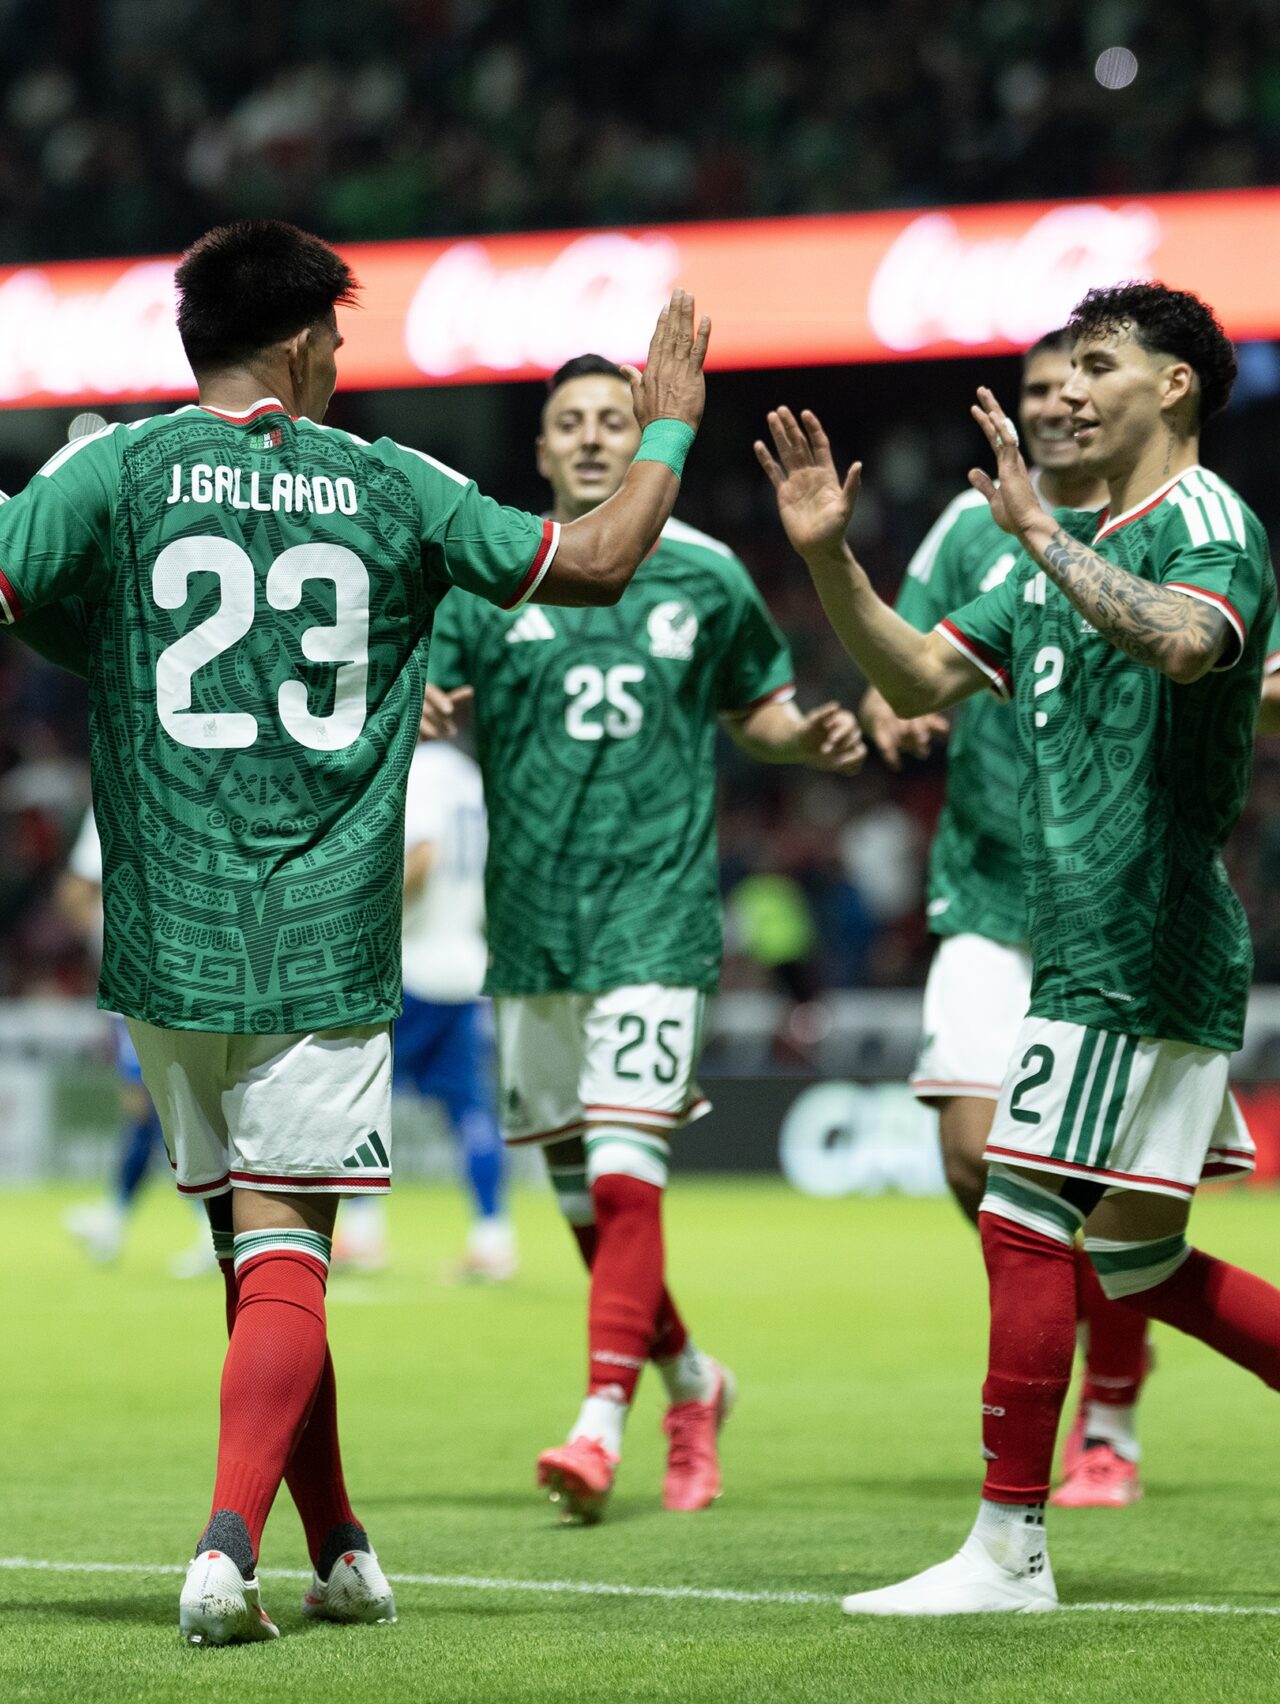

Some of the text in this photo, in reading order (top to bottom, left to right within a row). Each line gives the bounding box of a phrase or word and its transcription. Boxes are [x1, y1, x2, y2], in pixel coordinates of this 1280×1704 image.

[167, 464, 358, 515] J.GALLARDO
[152, 536, 370, 751] 23
[564, 664, 646, 741] 25
[615, 1014, 681, 1084] 25
[1010, 1043, 1055, 1125] 2
